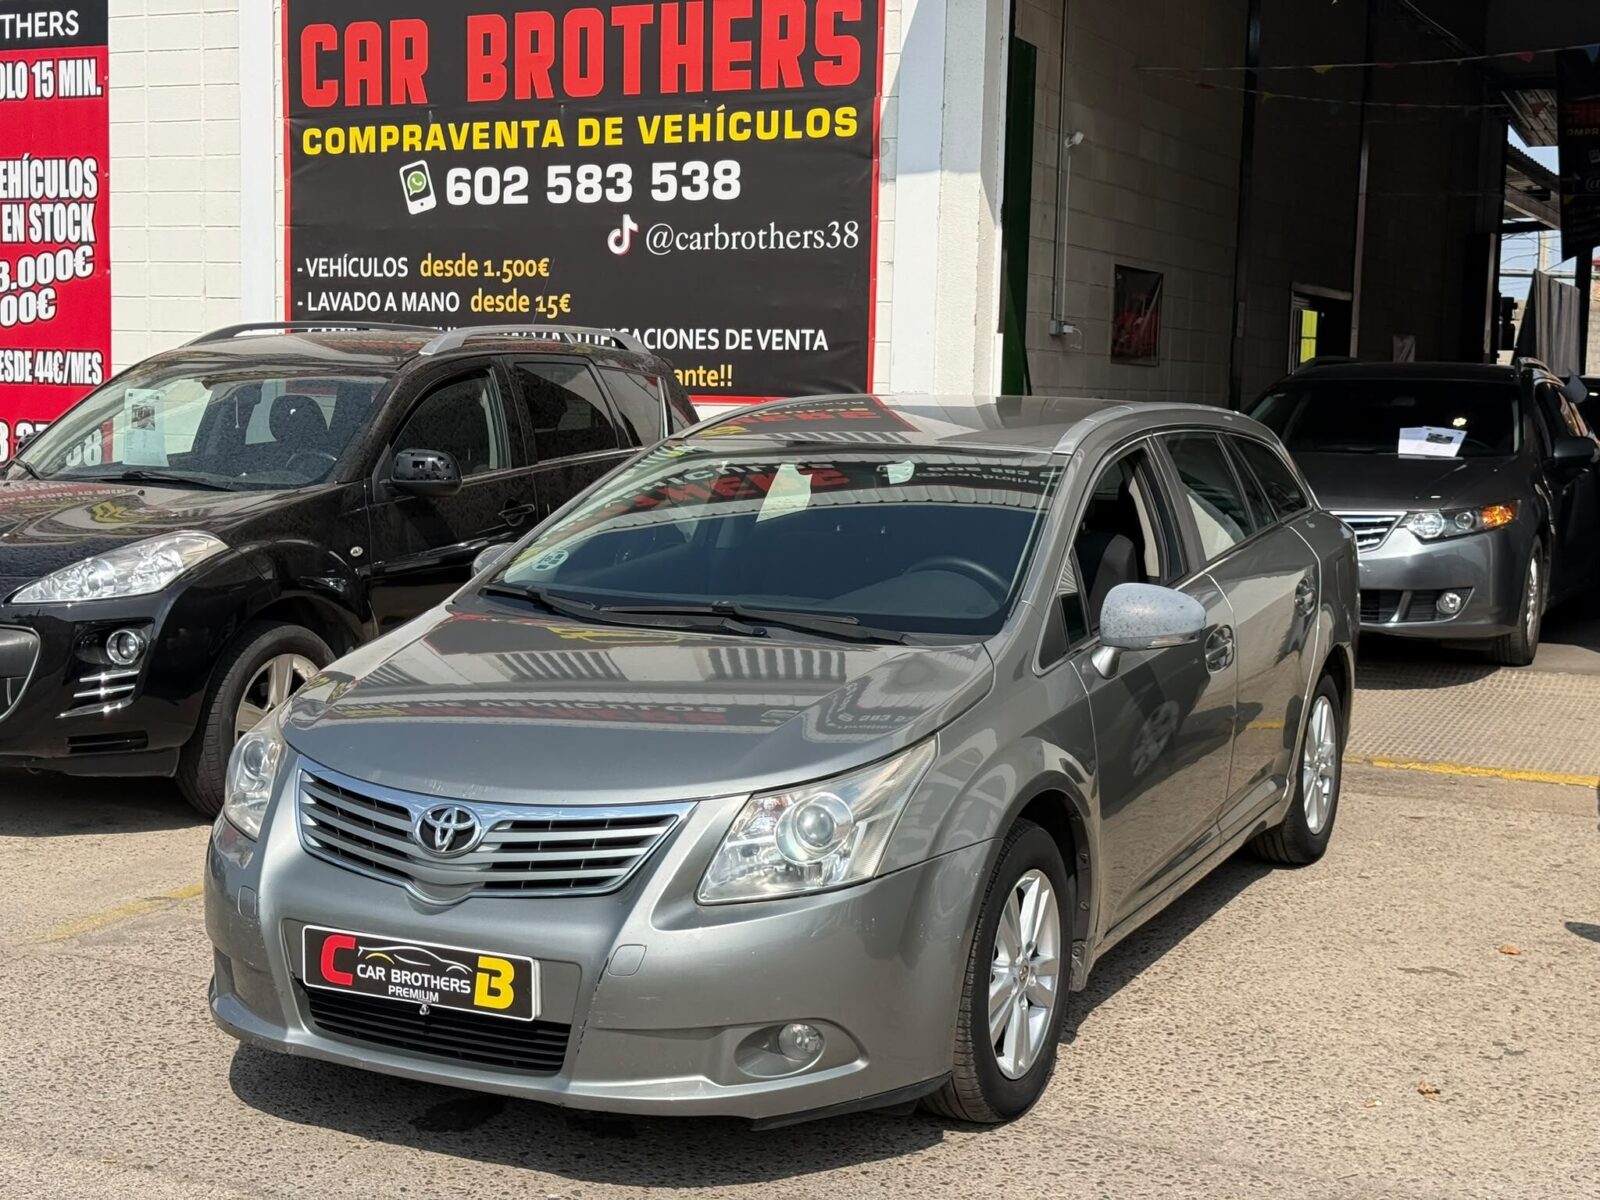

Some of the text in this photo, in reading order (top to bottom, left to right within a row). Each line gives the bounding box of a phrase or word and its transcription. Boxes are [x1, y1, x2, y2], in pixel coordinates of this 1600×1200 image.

[0, 9, 80, 39] THERS
[300, 0, 862, 108] CAR BROTHERS
[31, 59, 55, 99] 15
[58, 57, 103, 98] MIN.
[302, 103, 858, 155] COMPRAVENTA DE VEHÍCULOS
[0, 152, 99, 200] EHÍCULOS
[445, 159, 742, 207] 602 583 538
[1, 201, 97, 244] EN STOCK
[645, 219, 860, 256] @carbrothers38
[305, 253, 409, 278] VEHÍCULOS
[420, 252, 479, 278] desde
[484, 256, 551, 284] 1.500€
[0, 287, 57, 327] 00€
[307, 291, 382, 313] LAVADO
[384, 292, 398, 313] A
[401, 291, 461, 313] MANO
[470, 287, 530, 313] desde
[534, 292, 572, 319] 15€
[725, 328, 754, 350] DE
[756, 328, 830, 351] VENTA
[0, 349, 104, 385] ESDE 44€/MES
[673, 364, 733, 387] ante!!
[356, 963, 472, 995] CAR BROTHERS
[388, 984, 440, 1003] PREMIUM
